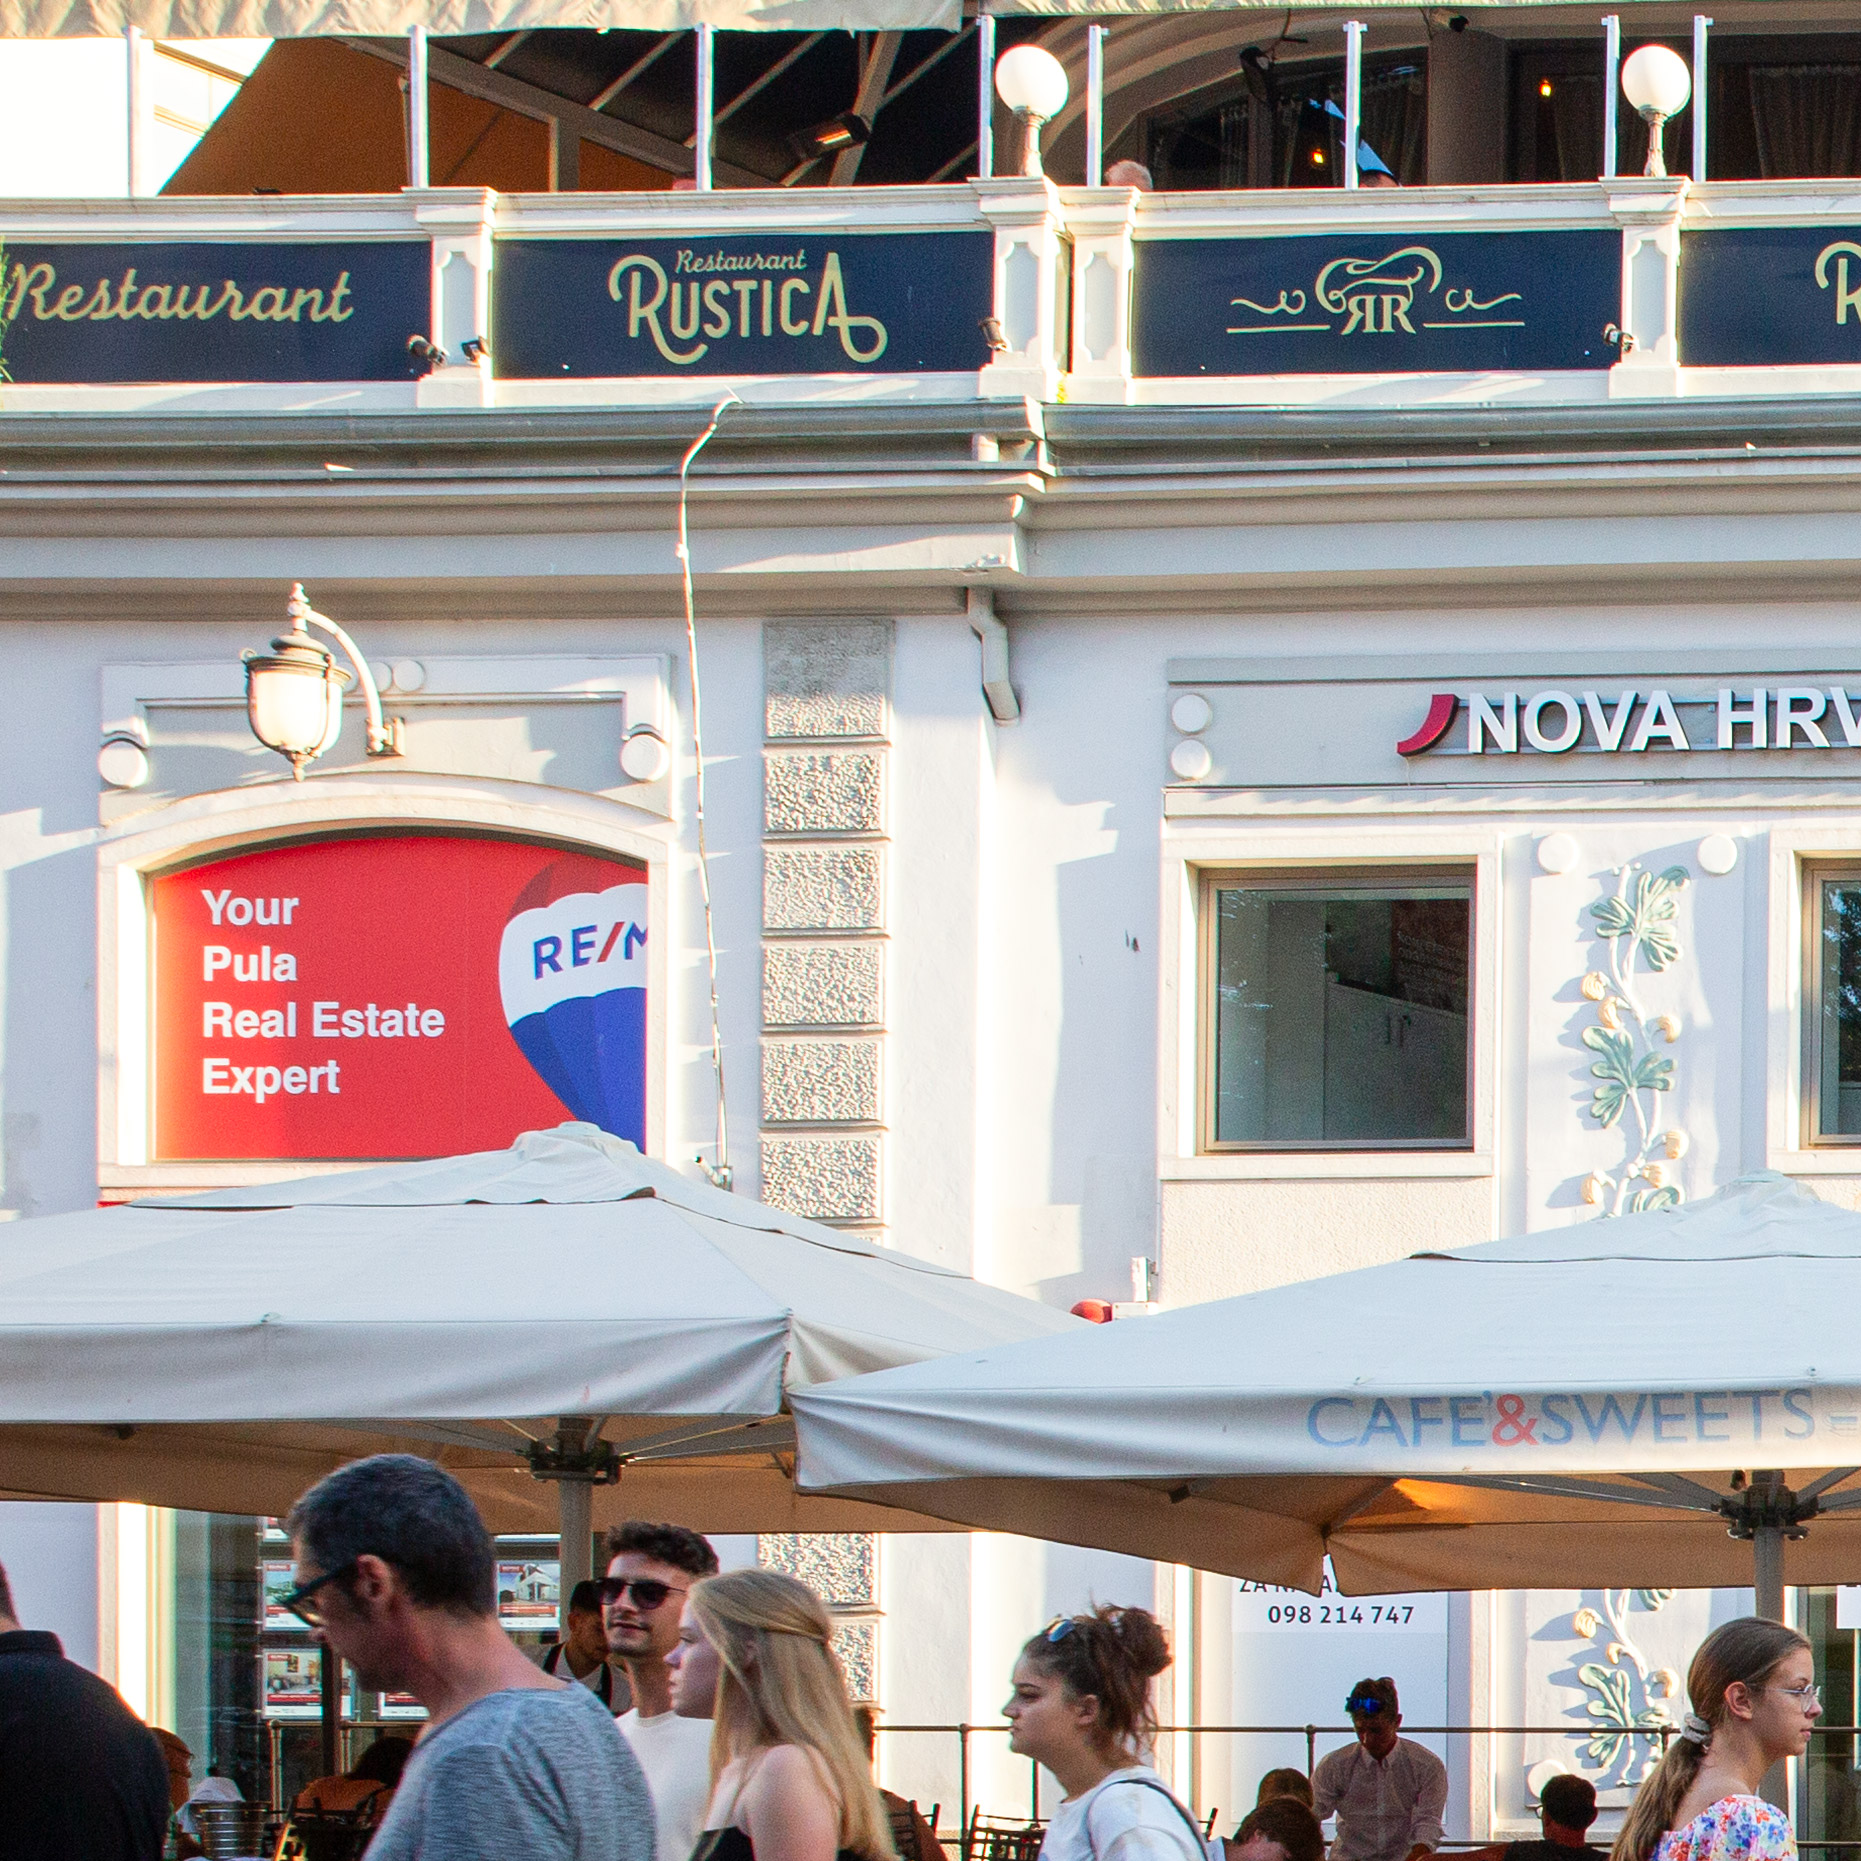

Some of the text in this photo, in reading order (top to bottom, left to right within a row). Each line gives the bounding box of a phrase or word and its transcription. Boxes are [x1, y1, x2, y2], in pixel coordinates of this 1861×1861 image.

[675, 249, 807, 273] Restaurant
[7, 262, 354, 323] Restaurant
[609, 252, 888, 364] RUSTICA
[1467, 690, 1690, 754] NOVA
[201, 889, 299, 926] Your
[203, 945, 298, 982] Pula
[203, 1001, 446, 1038] Real Estate
[202, 1058, 341, 1104] Expert
[1267, 1605, 1415, 1625] 098 214 747
